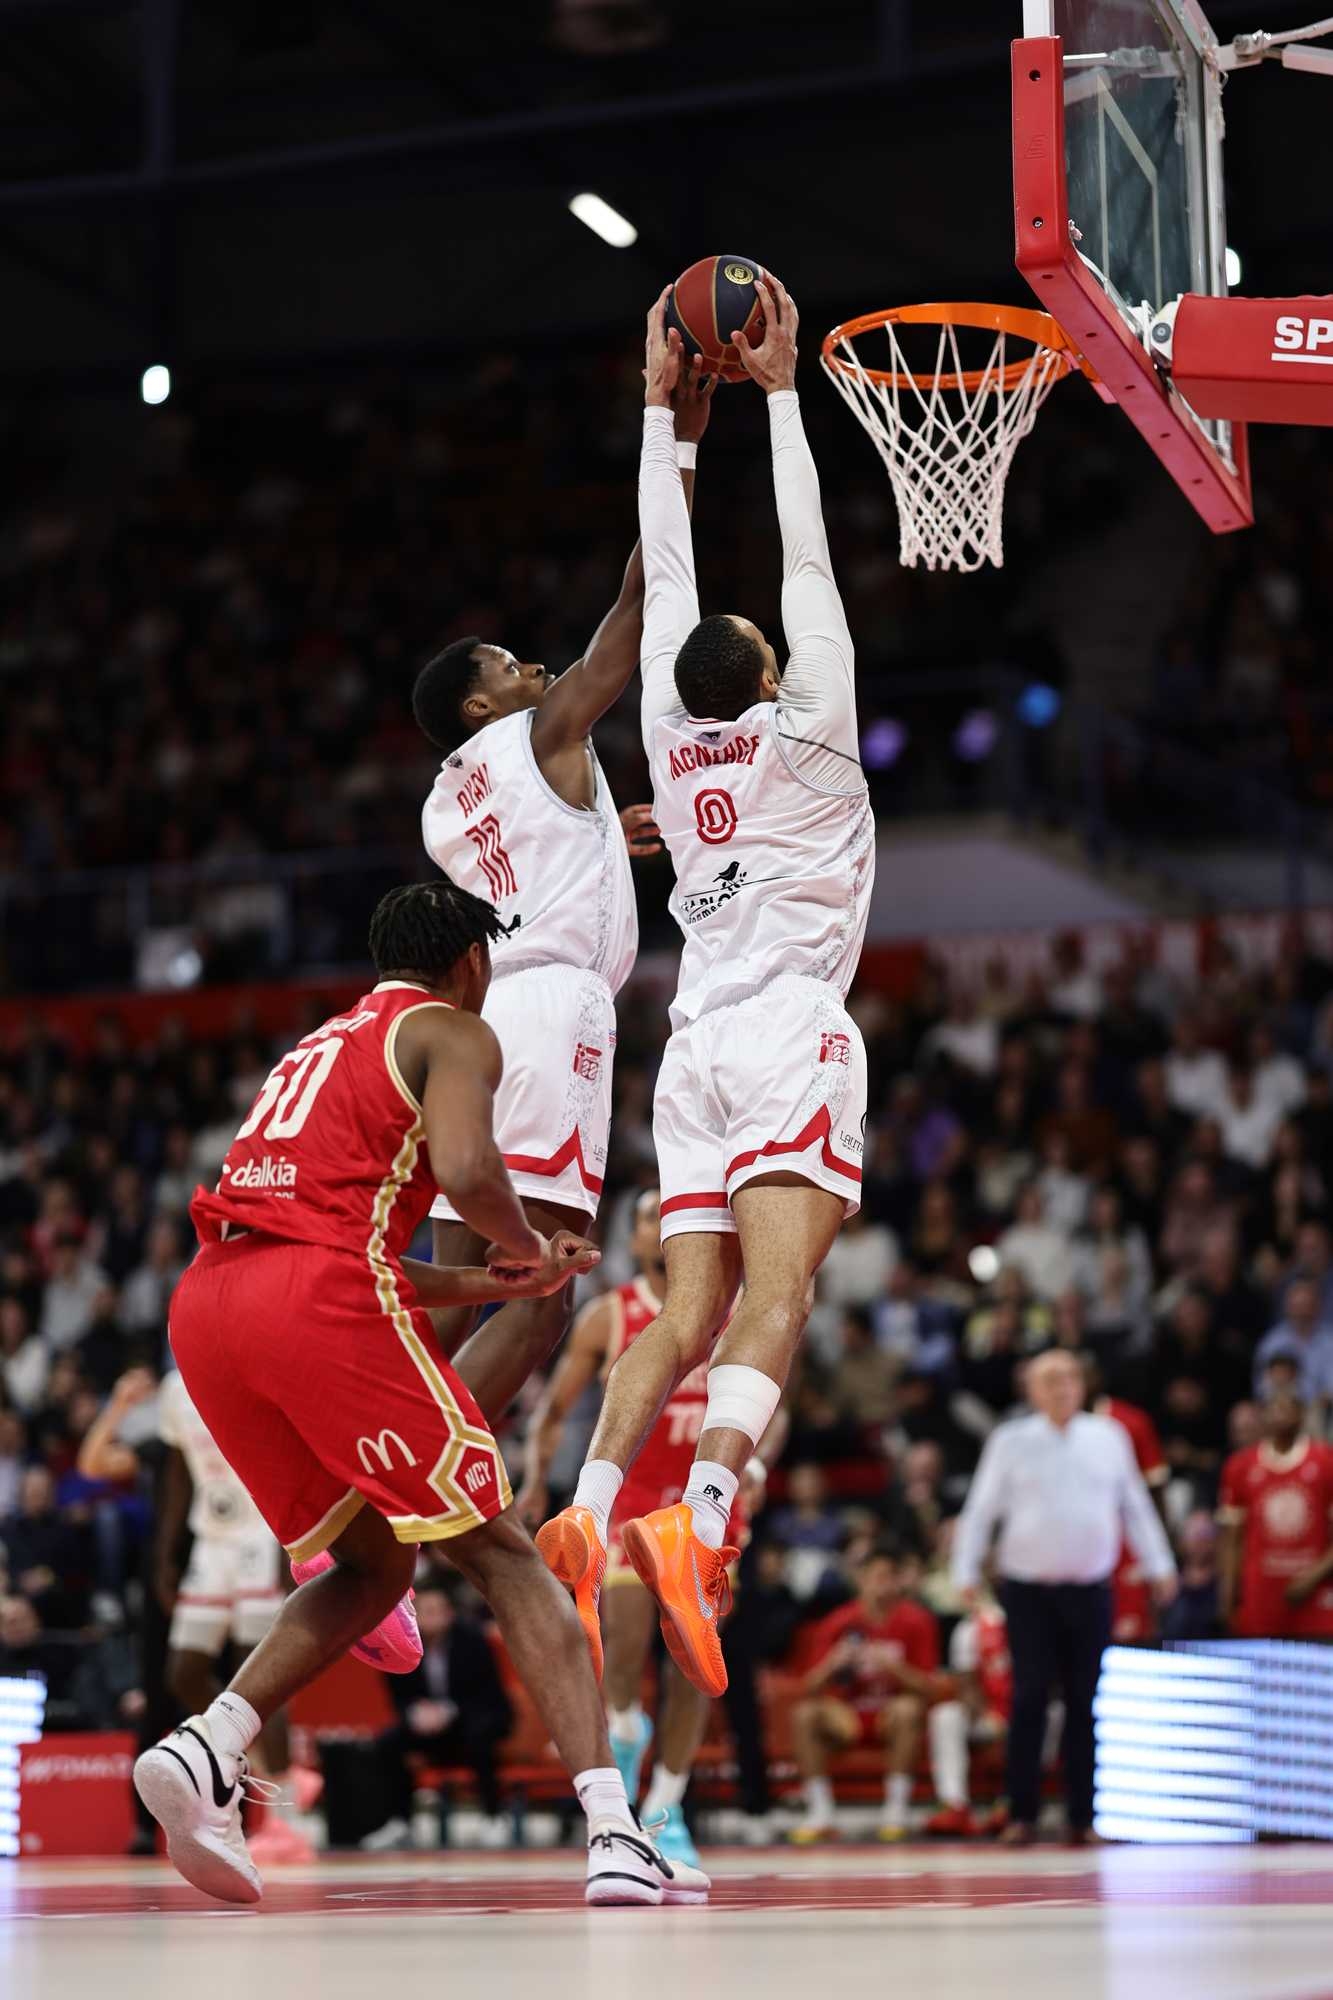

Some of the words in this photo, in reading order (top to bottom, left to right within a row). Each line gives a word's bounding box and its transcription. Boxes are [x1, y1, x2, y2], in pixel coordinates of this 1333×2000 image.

[1273, 315, 1333, 351] SP
[694, 788, 739, 845] 0
[234, 1036, 345, 1141] 50
[230, 1155, 298, 1188] dalkia
[464, 1460, 492, 1493] NCY
